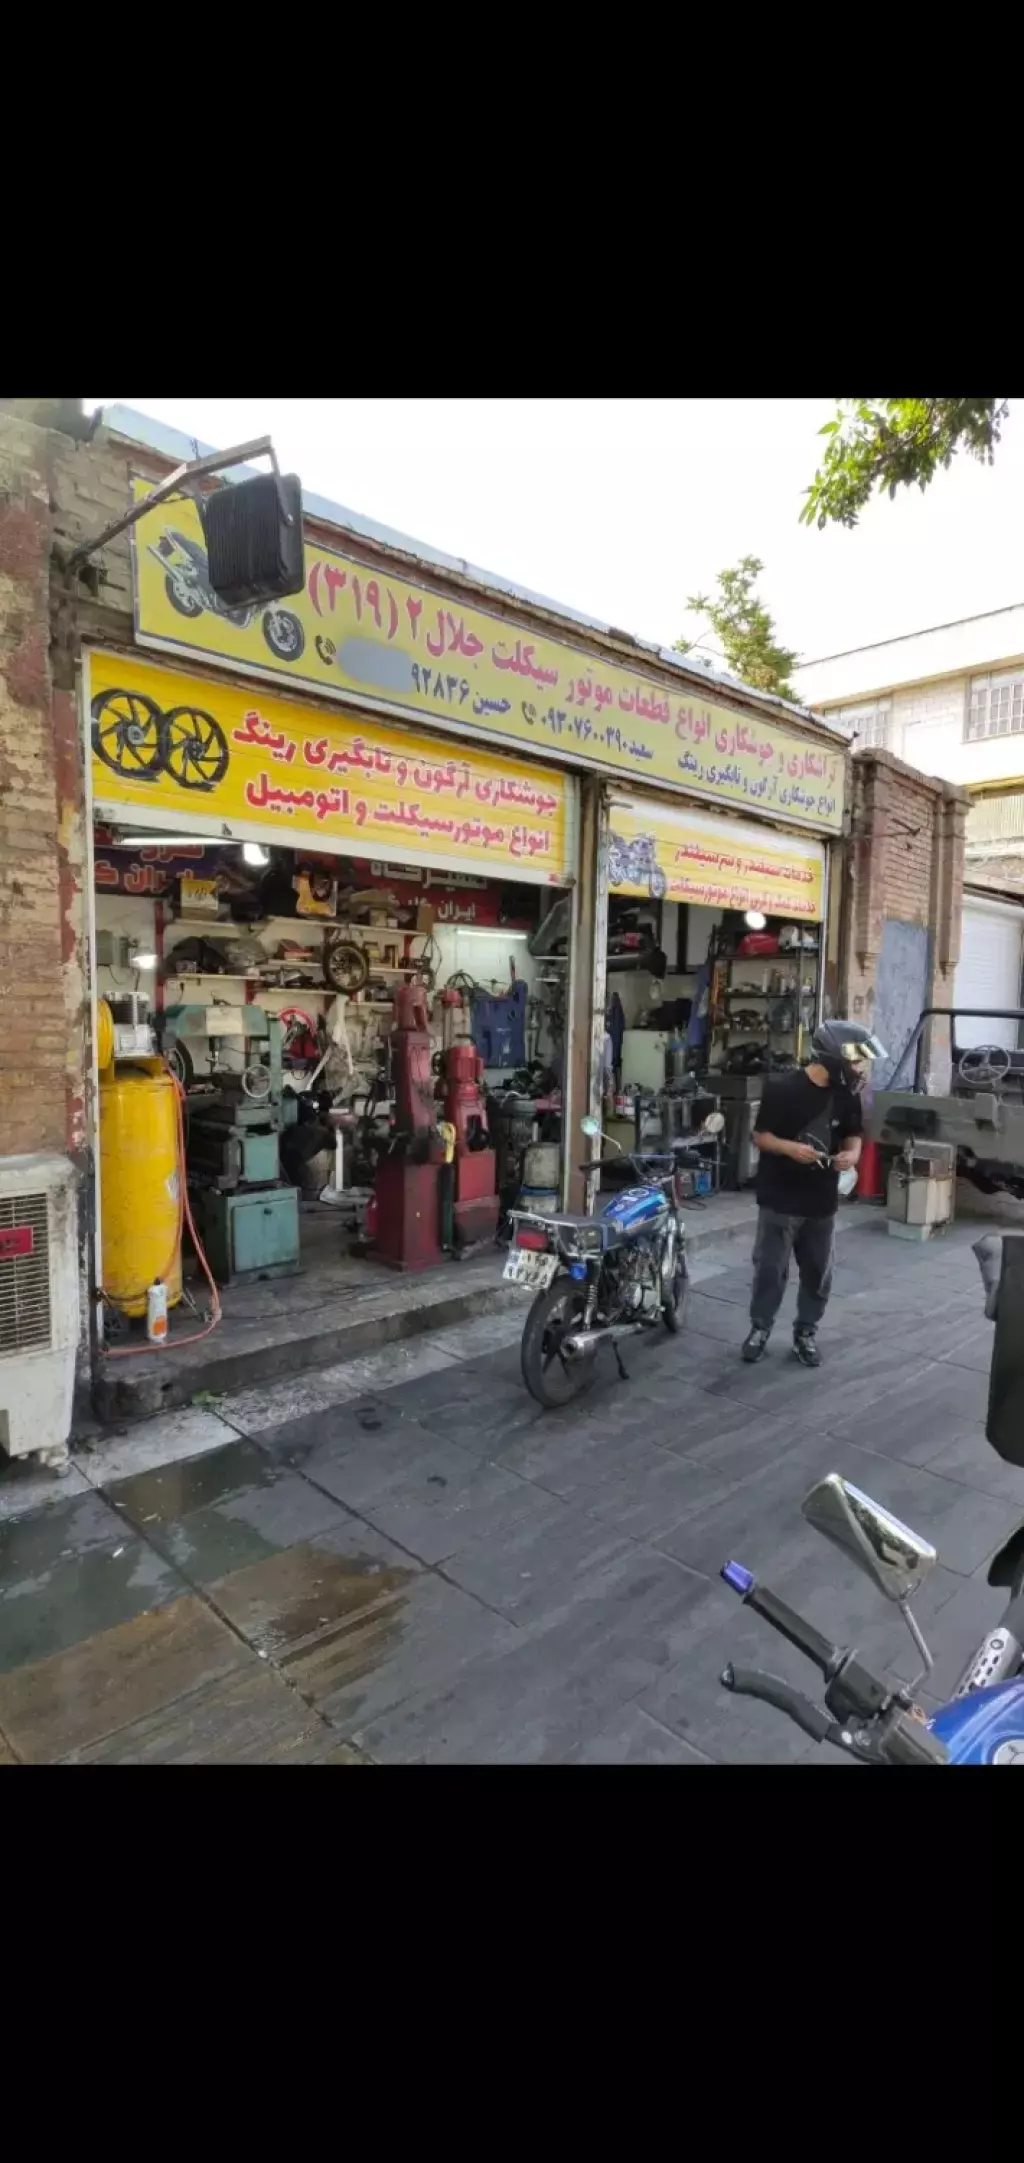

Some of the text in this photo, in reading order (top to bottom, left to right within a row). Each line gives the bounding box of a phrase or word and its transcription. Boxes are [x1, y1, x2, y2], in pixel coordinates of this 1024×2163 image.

[426, 608, 485, 670] جلال
[491, 639, 559, 691] سیکلت
[472, 691, 512, 716] حسین
[565, 667, 613, 712] موتور
[618, 685, 670, 724] قطعات
[675, 707, 712, 744] انواع
[714, 722, 774, 767] جوشکاری
[232, 711, 558, 817] جوشکاری آرگون و تابگیری رینگ
[628, 740, 654, 762] سعید
[246, 772, 350, 819] اتومبیل
[355, 800, 367, 826] و
[779, 784, 816, 811] جوشکاری
[817, 796, 836, 817] انواع
[508, 825, 550, 858] انواع
